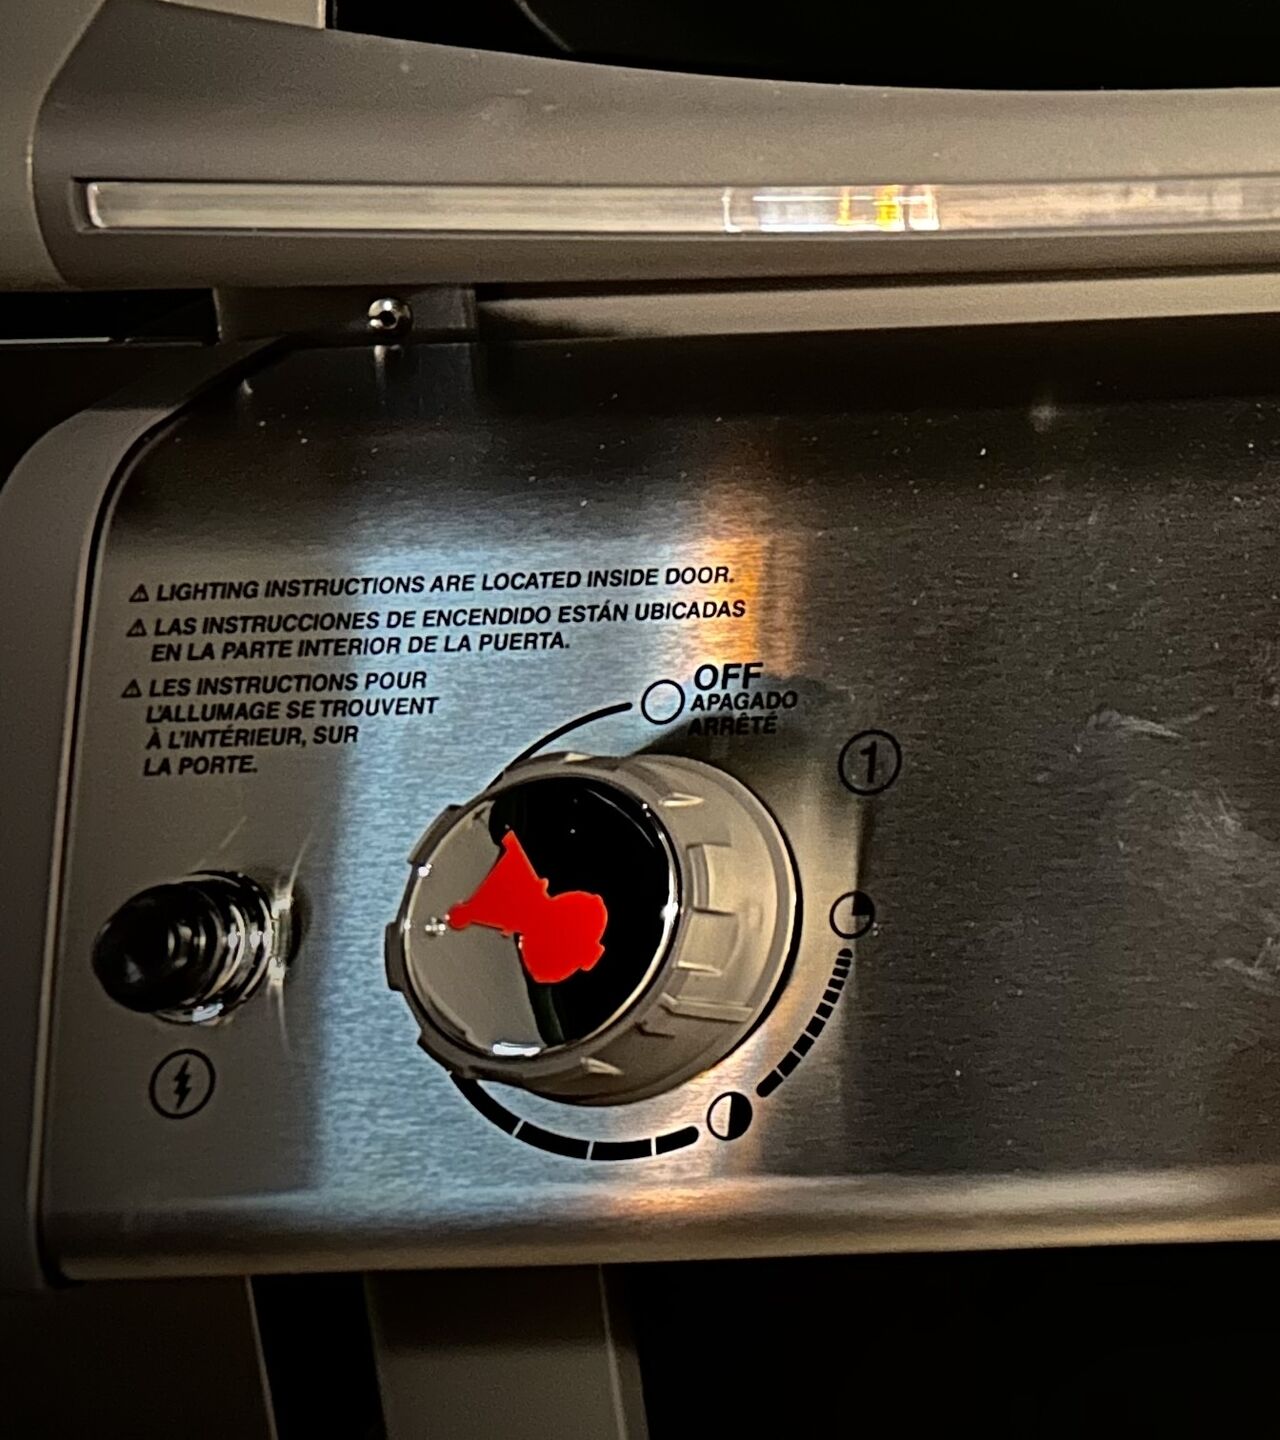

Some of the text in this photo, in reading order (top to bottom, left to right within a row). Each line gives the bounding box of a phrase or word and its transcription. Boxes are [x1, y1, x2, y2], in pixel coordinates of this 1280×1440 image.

[156, 565, 735, 602] LIGHTING INSTRUCTIONS ARE LOCATED INSIDE DOOR.
[154, 599, 746, 636] LAS INSTRUCCIONES DE ENCENDIDO ESTÁN UBICADAS
[151, 632, 570, 662] EN LA PARTE INTERIOR DE LA PUERTA.
[149, 671, 428, 697] LES INSTRUCTIONS POUR
[694, 662, 764, 691] OFF
[146, 697, 440, 723] L'ALLUMAGE SE TROUVENT
[690, 690, 798, 711] APAGADO
[146, 727, 162, 750] À
[312, 725, 359, 745] SUR
[143, 755, 258, 777] LA PORTE.
